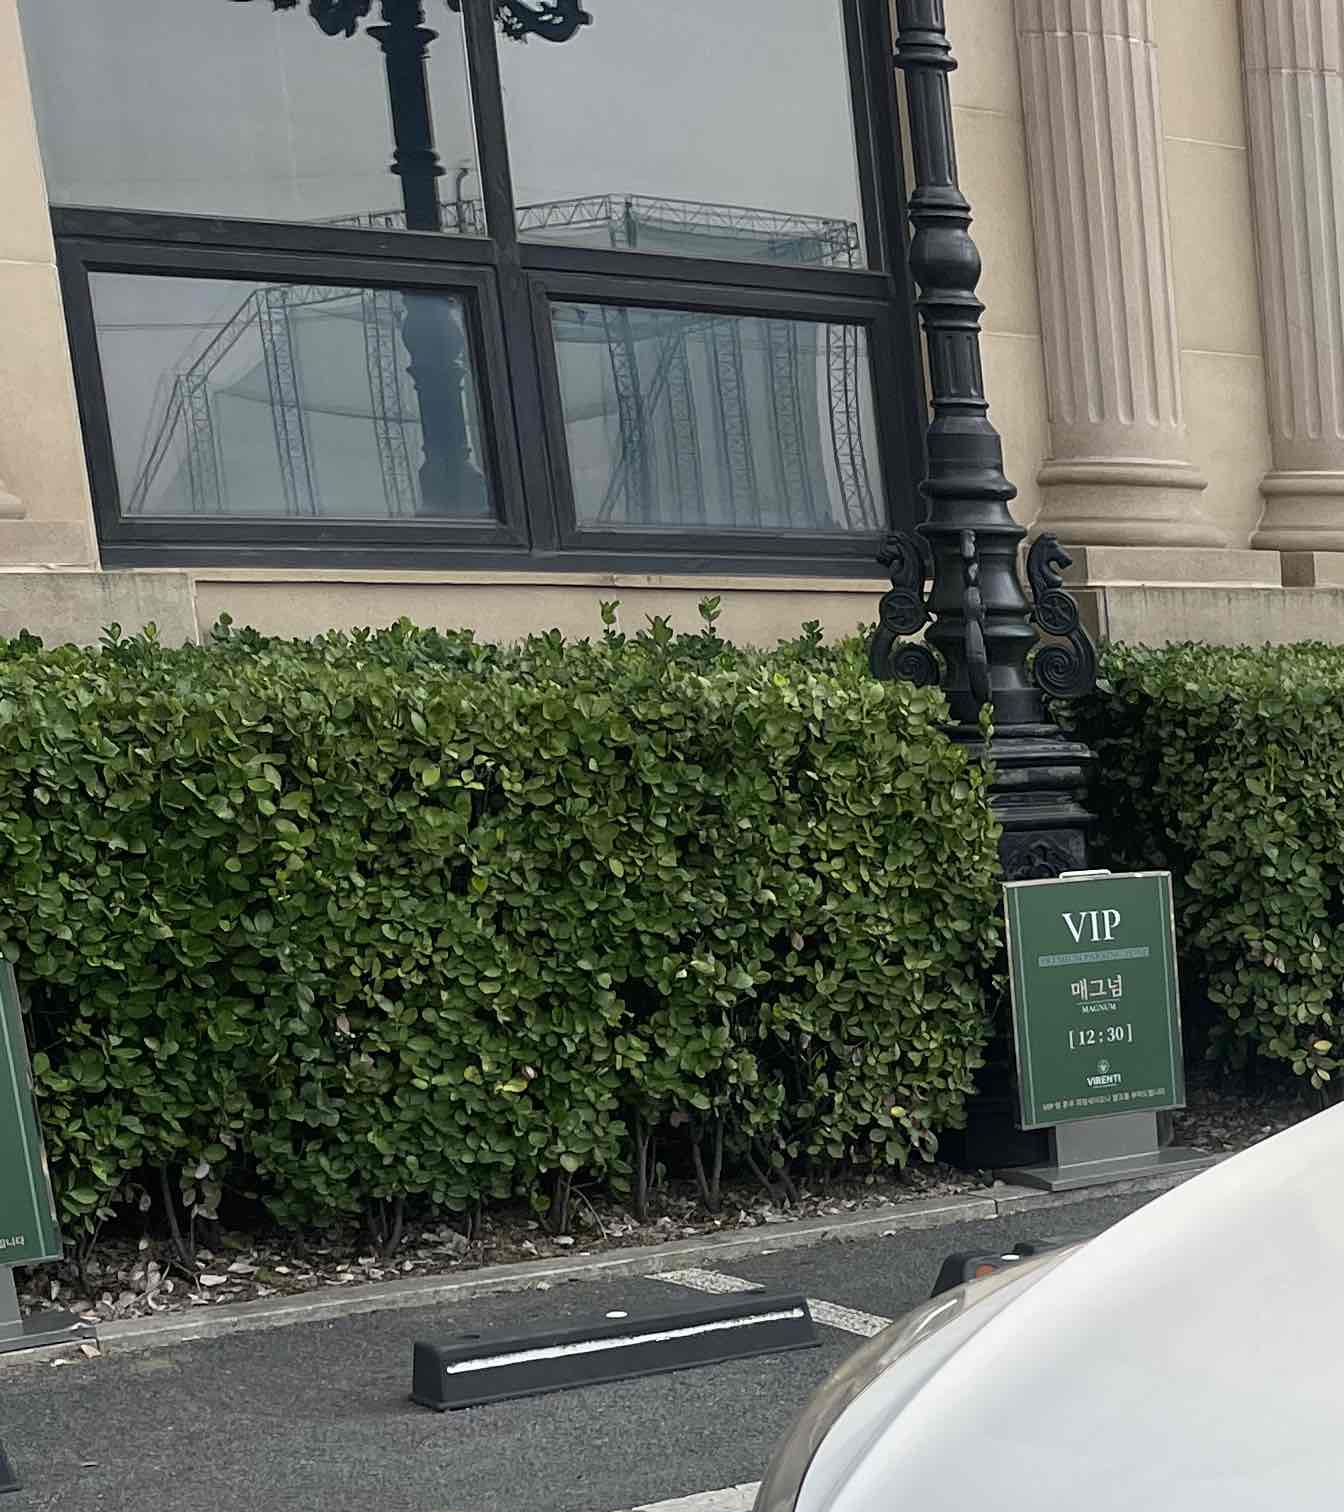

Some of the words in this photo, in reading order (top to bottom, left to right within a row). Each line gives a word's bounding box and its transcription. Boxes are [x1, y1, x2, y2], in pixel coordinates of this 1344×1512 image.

[1062, 908, 1121, 943] VIP
[1071, 974, 1123, 1001] 매그넘
[1082, 1002, 1117, 1014] MAGNUM
